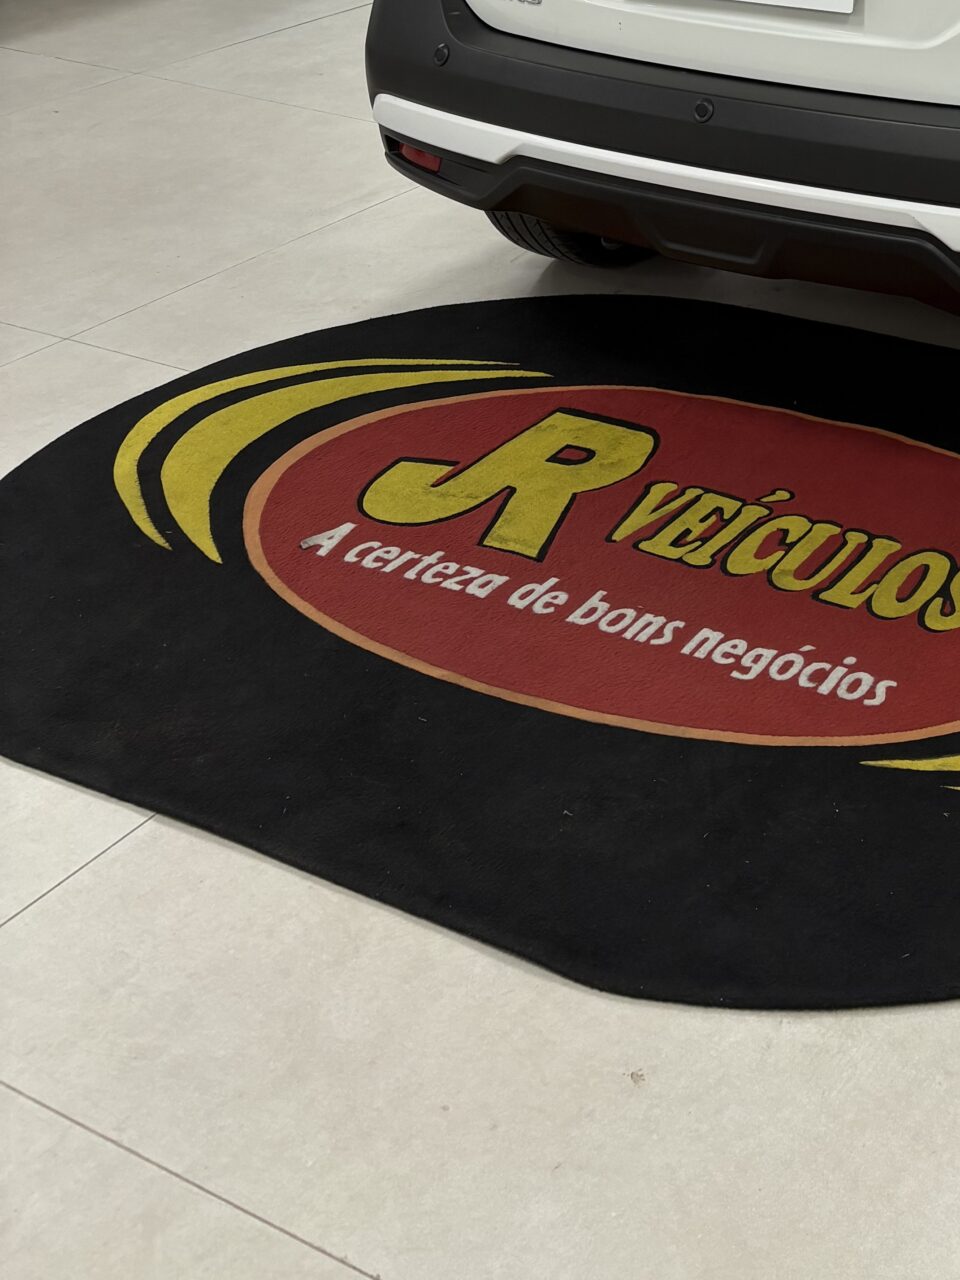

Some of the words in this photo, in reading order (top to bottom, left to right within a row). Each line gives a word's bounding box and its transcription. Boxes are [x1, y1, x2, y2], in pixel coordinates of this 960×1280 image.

[358, 407, 661, 562] JR
[300, 521, 358, 557] A
[343, 540, 510, 599] certeza
[507, 576, 569, 615] de
[565, 589, 686, 646] bons
[680, 626, 898, 707] negócios
